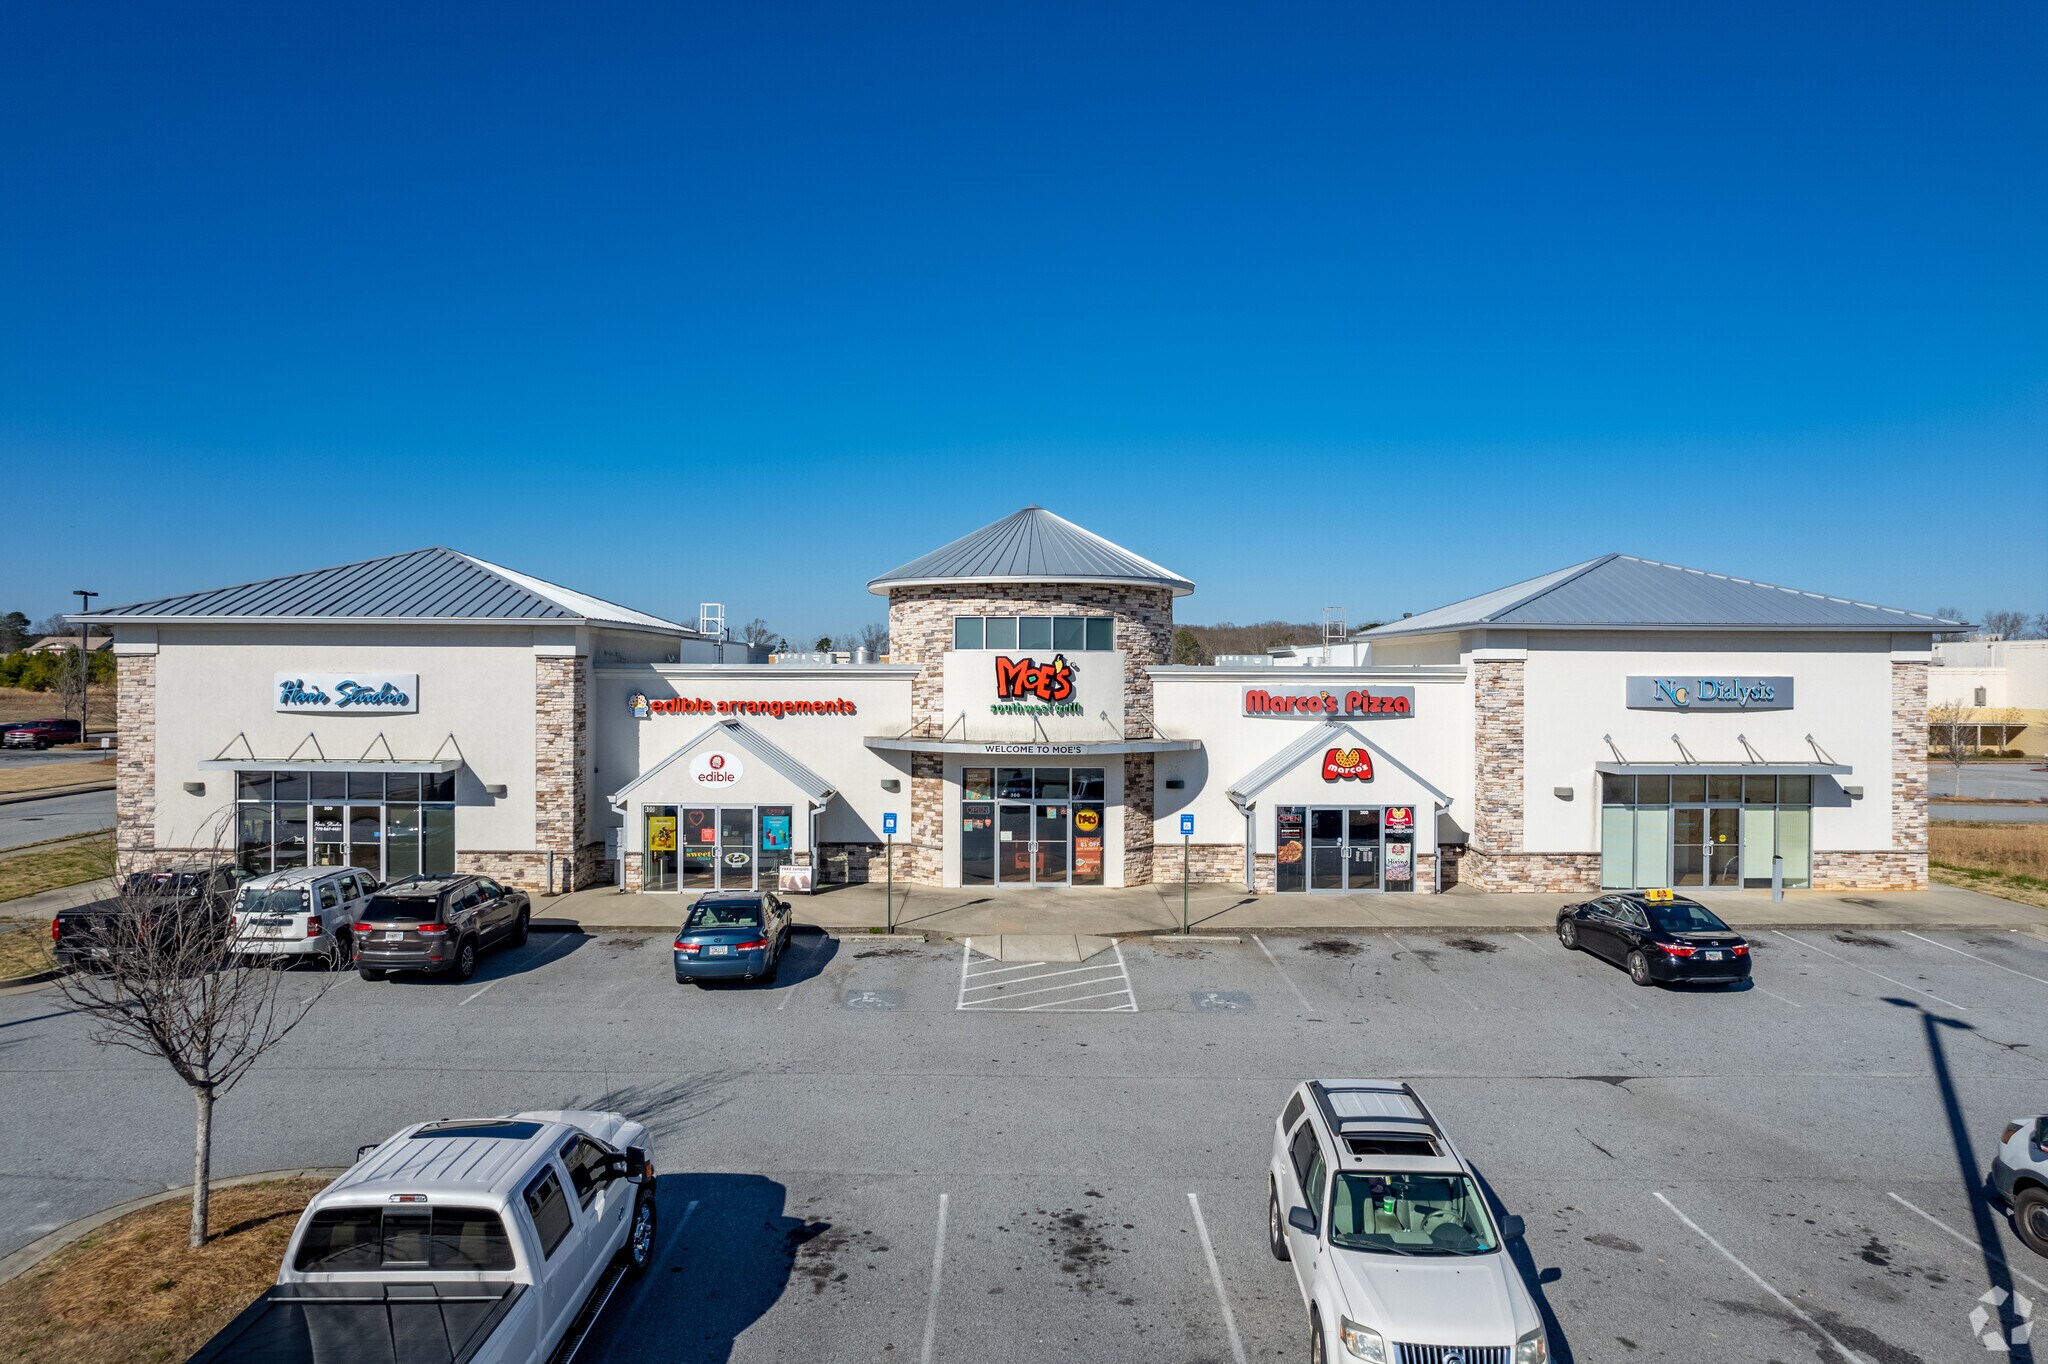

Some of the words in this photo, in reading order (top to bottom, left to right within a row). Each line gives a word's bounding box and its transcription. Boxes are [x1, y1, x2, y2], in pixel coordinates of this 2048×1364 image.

[995, 654, 1072, 701] MOE'S
[280, 679, 329, 704] Hair
[335, 680, 409, 705] Studio
[1246, 690, 1339, 713] Marco's
[1345, 690, 1410, 713] Pizza
[1654, 678, 1690, 706] NC
[1698, 678, 1775, 706] Dialysis
[651, 697, 713, 713] edible
[717, 697, 855, 716] arrangements
[990, 702, 1052, 714] southwest
[1055, 702, 1081, 716] grill
[985, 745, 1034, 754] WELCOME
[1036, 746, 1050, 754] TO
[1052, 746, 1082, 754] MOE'S
[698, 771, 735, 782] edible
[1328, 763, 1369, 774] marco's
